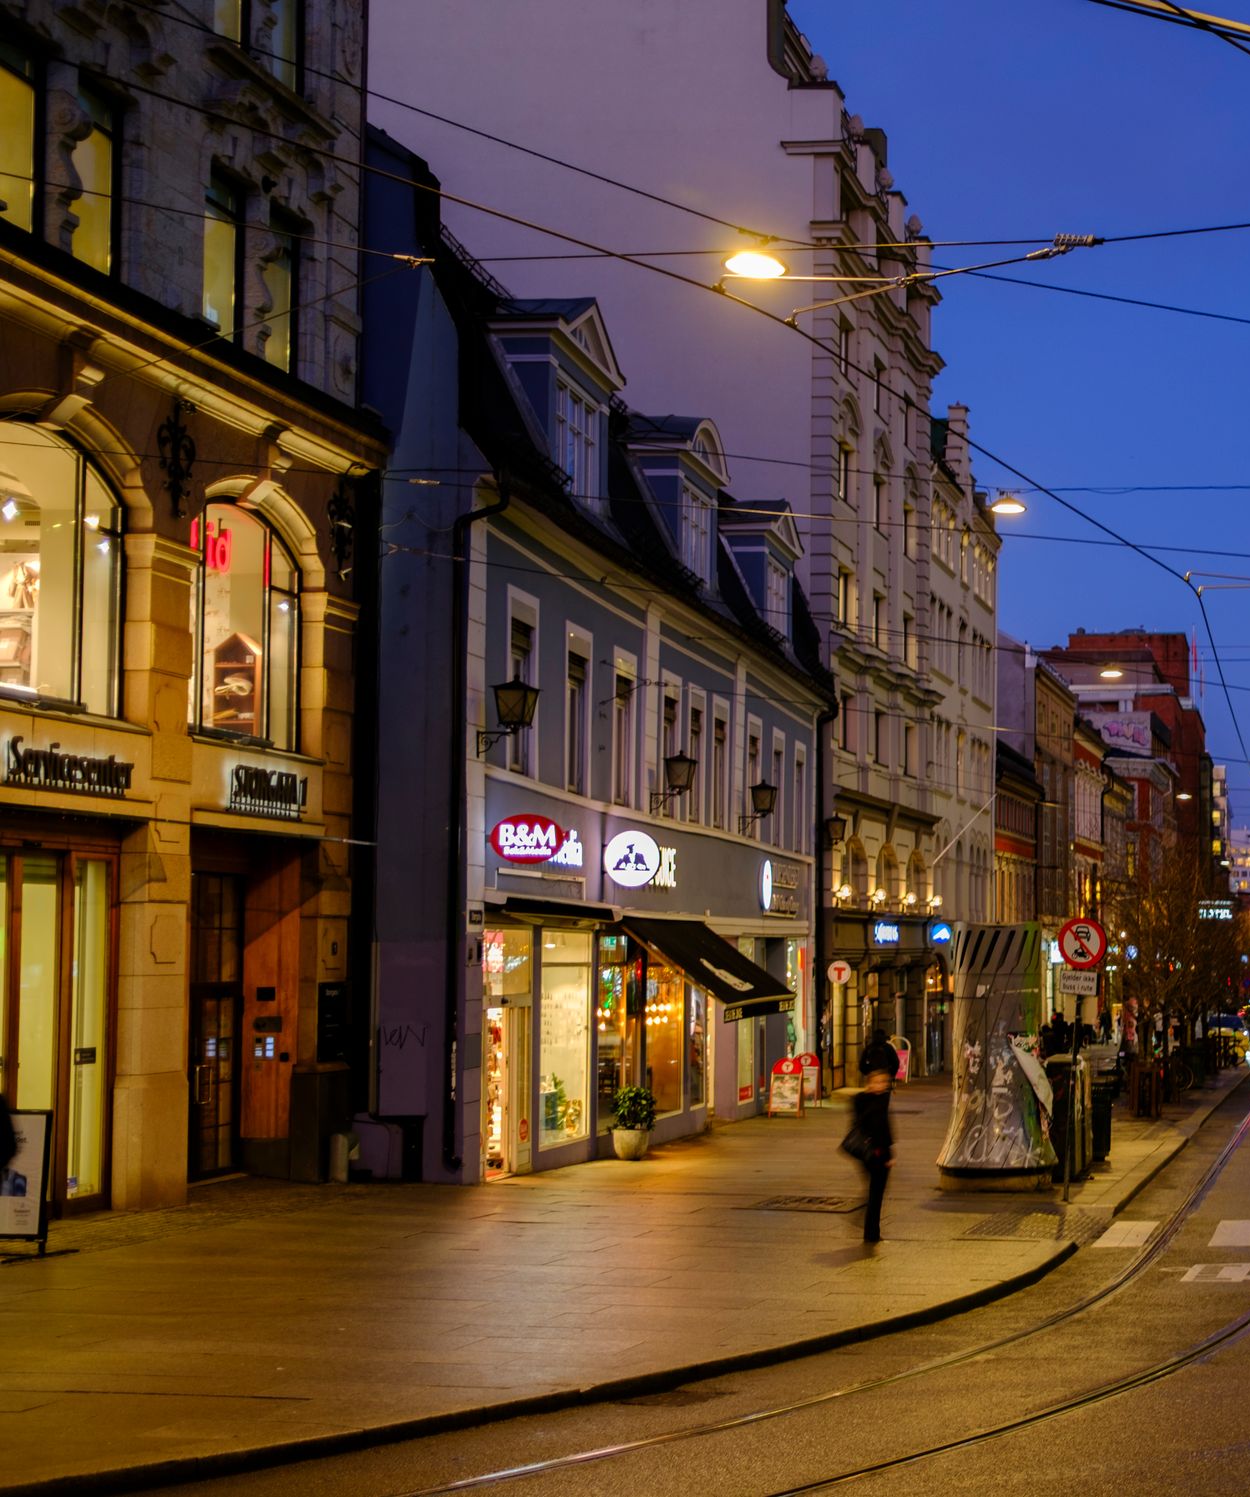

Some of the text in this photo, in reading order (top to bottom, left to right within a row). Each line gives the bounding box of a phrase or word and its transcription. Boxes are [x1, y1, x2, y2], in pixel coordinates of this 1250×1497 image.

[8, 735, 134, 790] Servicesenter
[499, 823, 557, 847] B&M
[833, 967, 846, 980] T
[1062, 974, 1082, 983] Gjelder
[1062, 983, 1076, 991] buss
